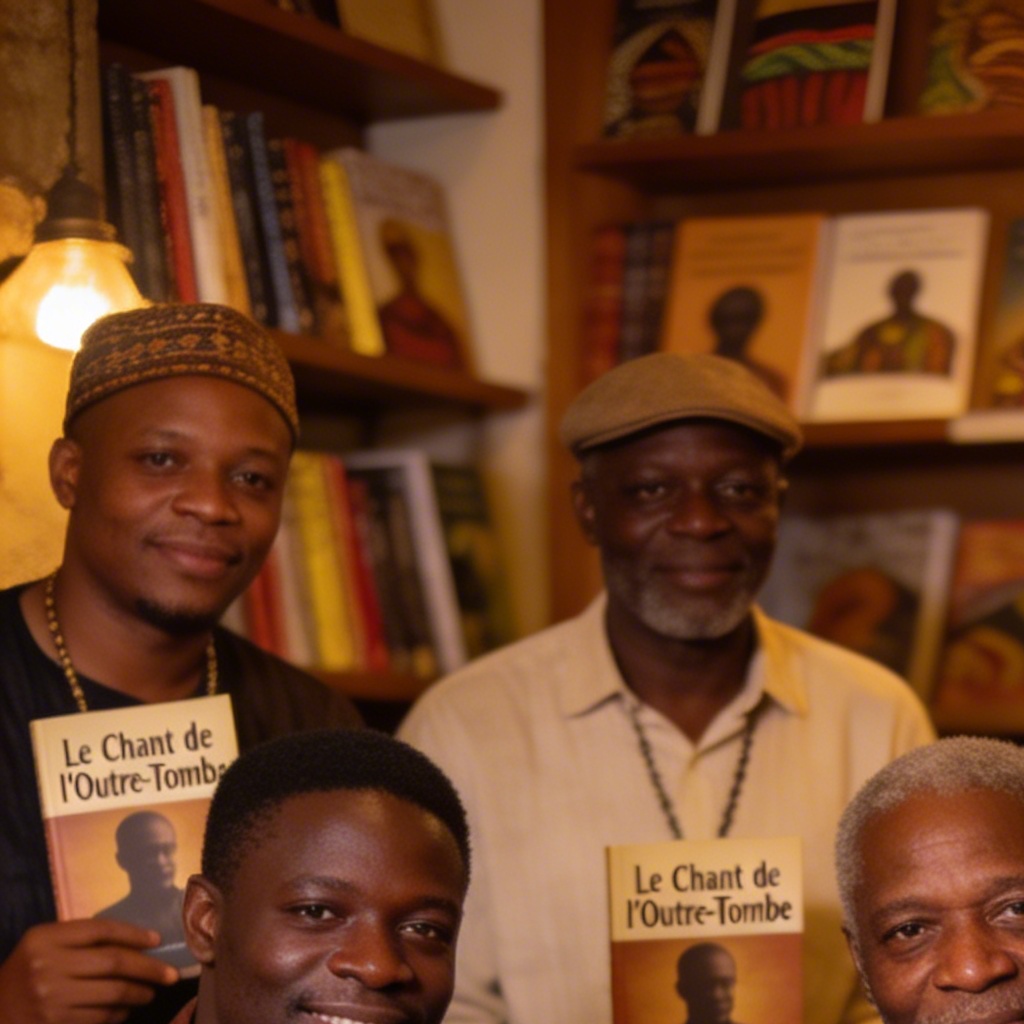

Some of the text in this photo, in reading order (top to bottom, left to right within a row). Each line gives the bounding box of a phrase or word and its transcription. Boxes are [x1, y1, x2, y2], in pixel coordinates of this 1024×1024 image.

[63, 720, 214, 767] Le Chant de
[636, 860, 780, 894] Le Chant de
[627, 893, 792, 929] l'Outre-Tombe
